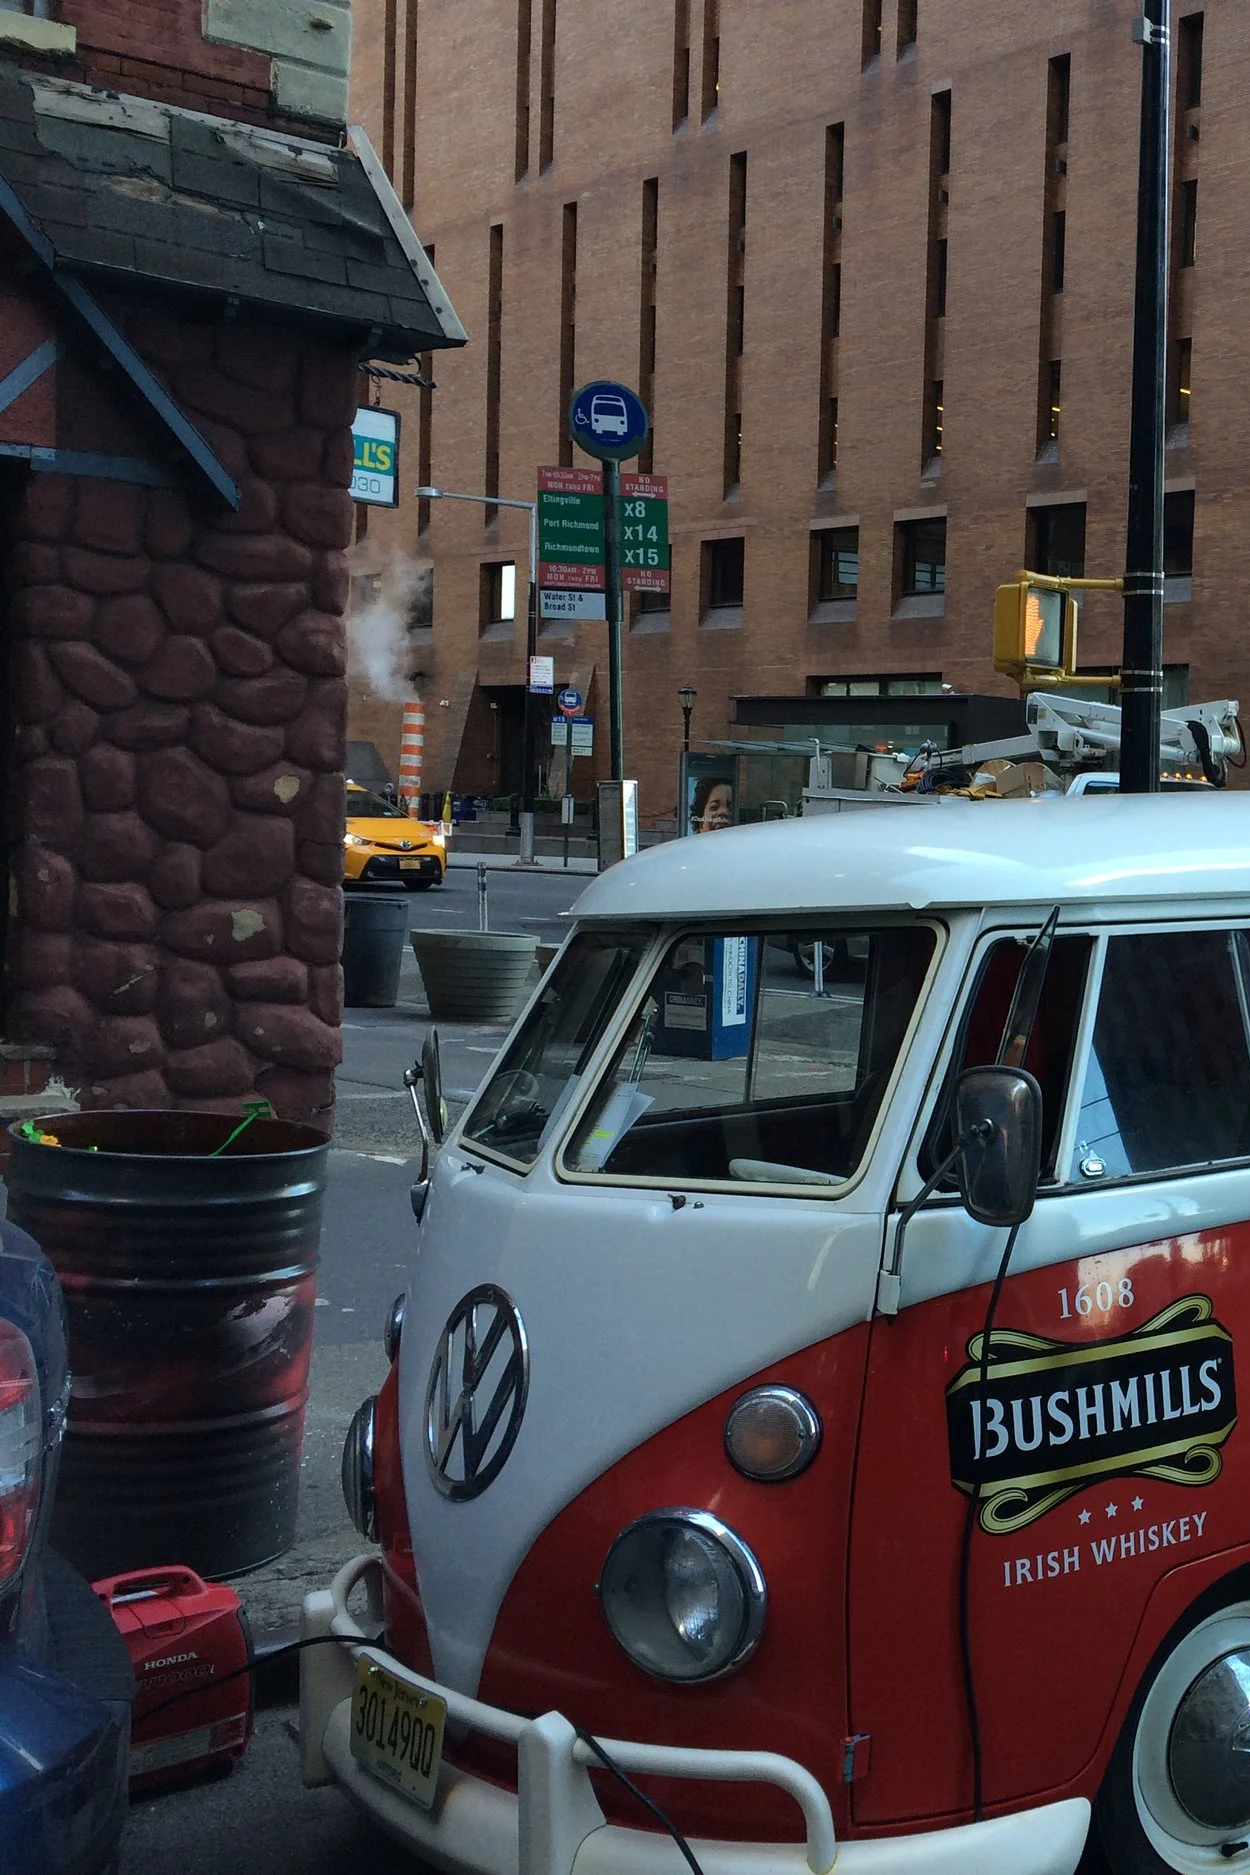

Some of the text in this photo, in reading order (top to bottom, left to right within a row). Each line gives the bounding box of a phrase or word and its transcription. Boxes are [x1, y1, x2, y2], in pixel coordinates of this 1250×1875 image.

[548, 481, 563, 489] MON
[625, 483, 664, 493] STANDING
[543, 495, 581, 505] Eltingville
[543, 518, 599, 530] Port Richmond
[544, 542, 600, 553] Richmondtown
[627, 577, 665, 586] STANDING
[544, 592, 566, 601] Water
[568, 593, 576, 601] St
[544, 602, 576, 611] Broad St
[1057, 1277, 1135, 1320] 1608
[1003, 1512, 1208, 1588] IRISH WHISKEY
[143, 1651, 199, 1670] HONDA
